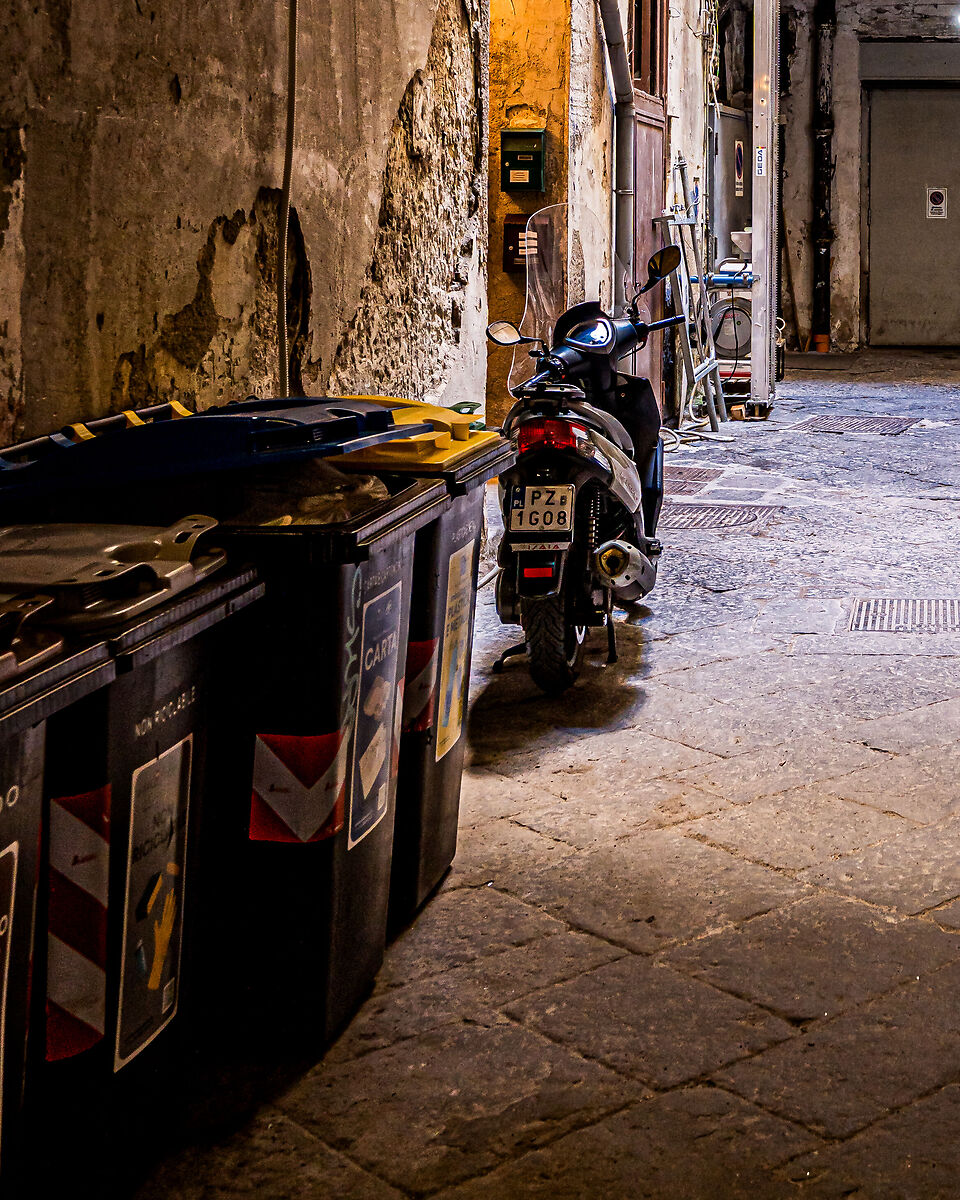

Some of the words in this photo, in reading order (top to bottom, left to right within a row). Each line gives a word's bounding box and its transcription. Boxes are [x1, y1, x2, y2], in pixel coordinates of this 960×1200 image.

[513, 499, 524, 507] PL
[531, 490, 556, 506] PZ
[516, 510, 567, 526] 1G08
[364, 630, 398, 671] CARTA
